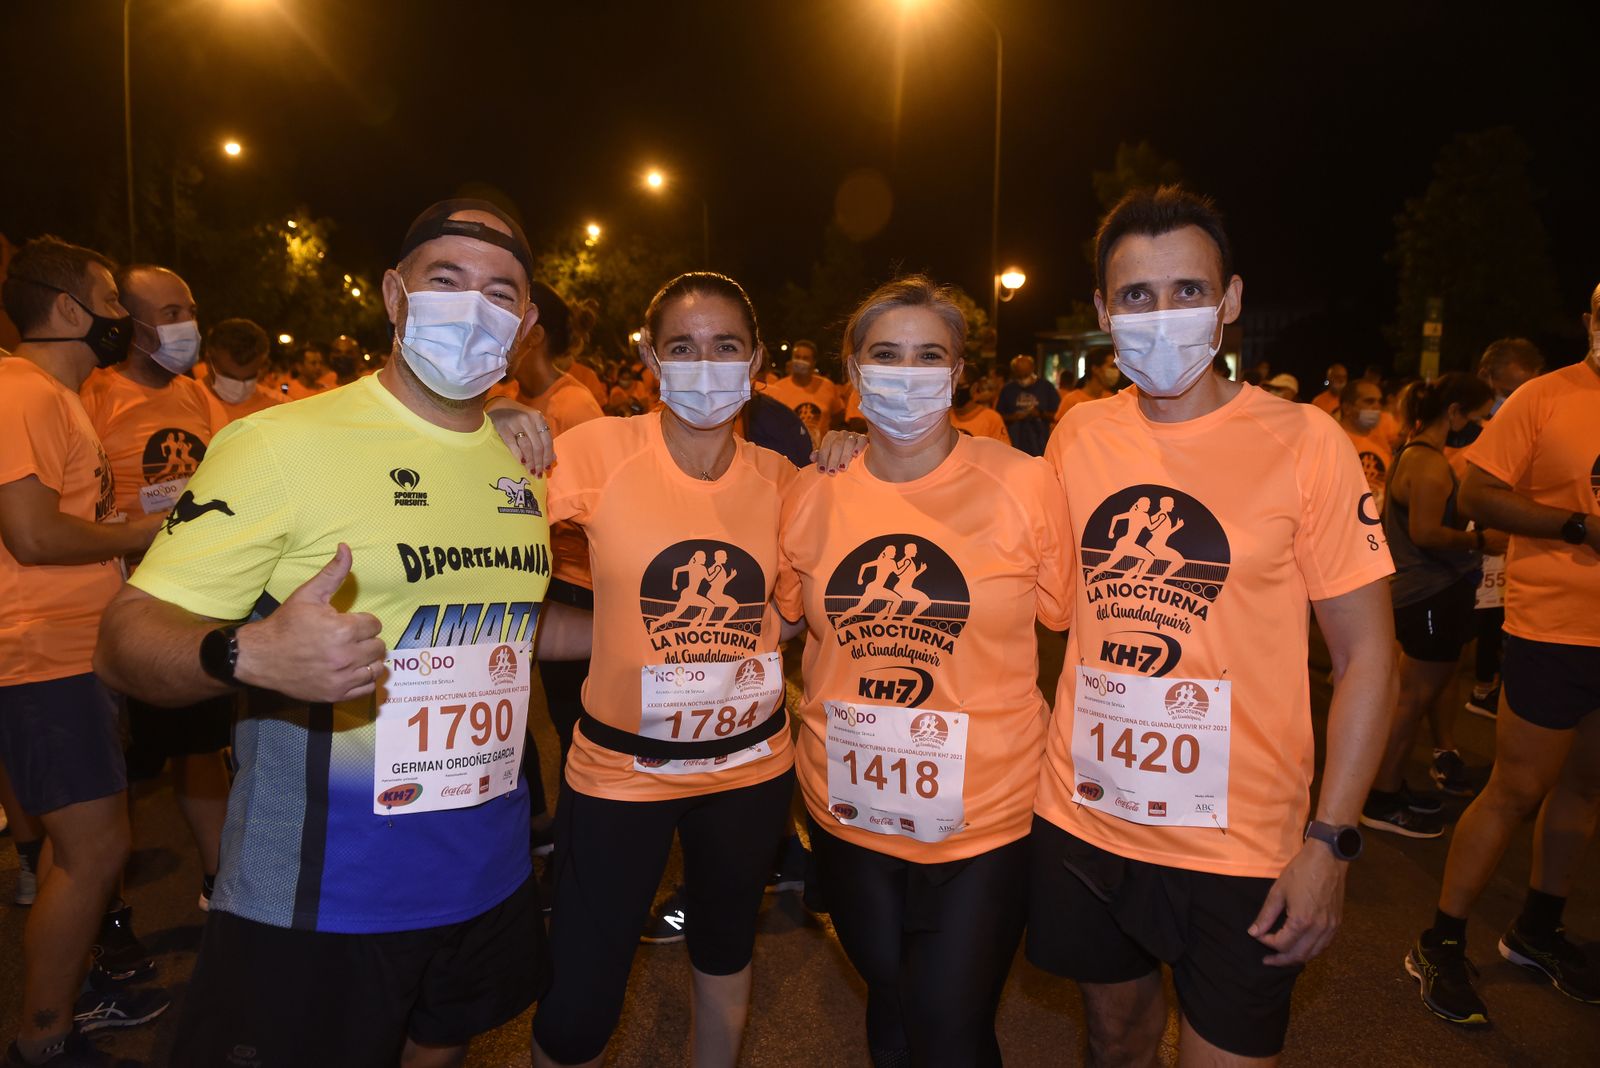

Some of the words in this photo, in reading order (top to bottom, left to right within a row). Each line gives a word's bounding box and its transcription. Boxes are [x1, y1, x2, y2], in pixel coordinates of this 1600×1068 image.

[394, 491, 428, 499] SPORTING
[397, 543, 550, 583] DEPORTEMANIA
[1087, 587, 1104, 604] LA
[1106, 583, 1209, 621] NOCTURNA
[1096, 603, 1111, 620] del
[1110, 602, 1192, 634] Guadalquivir
[651, 635, 672, 652] LA
[674, 630, 757, 652] NOCTURNA
[837, 630, 857, 647] LA
[858, 624, 954, 655] NOCTURNA
[664, 651, 681, 664] del
[851, 643, 867, 660] del
[866, 641, 940, 667] Guadalquivir
[403, 695, 434, 703] CARRERA
[434, 691, 467, 701] NOCTURNA
[408, 698, 513, 753] 1790
[665, 701, 759, 740] 1784
[1108, 714, 1138, 725] NOCTURNA
[1138, 719, 1150, 727] DEL
[1150, 721, 1198, 730] GUADALQUIVIR
[391, 759, 443, 774] GERMAN
[446, 752, 492, 770] ORDOÑEZ
[492, 746, 515, 762] GARCIA
[858, 743, 887, 752] NOCTURNA
[897, 748, 937, 757] GUADALQUIVIR
[1090, 721, 1200, 774] 1420
[843, 750, 939, 799] 1418
[1195, 803, 1215, 811] ABC
